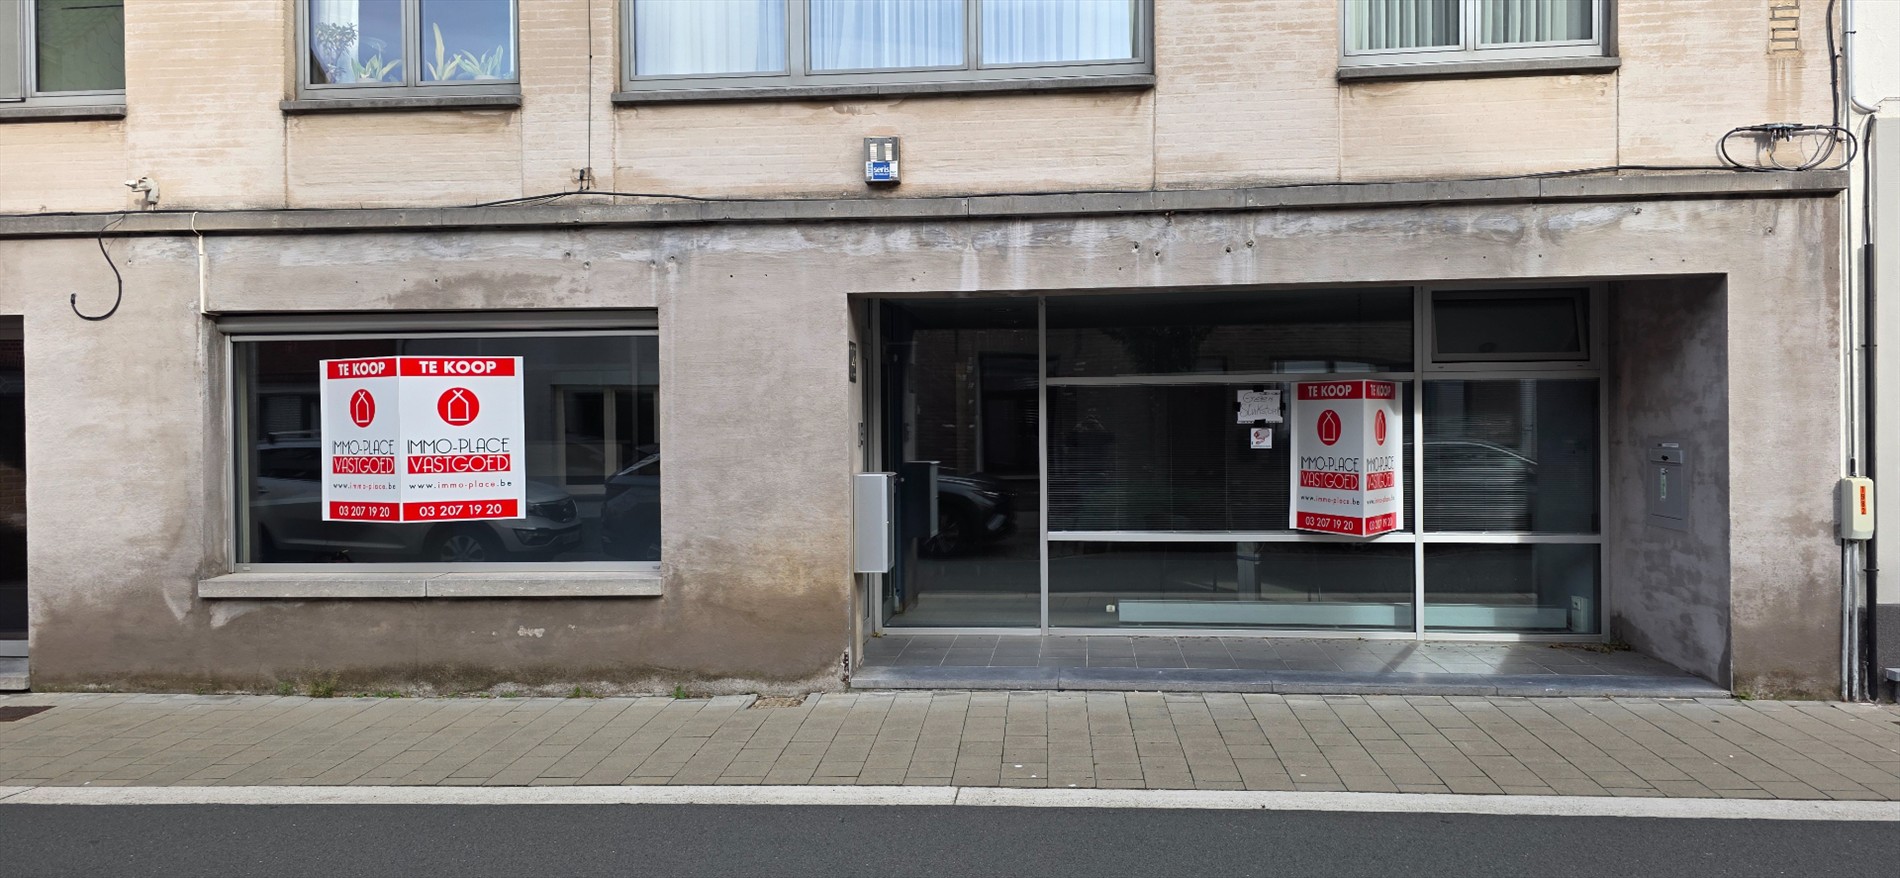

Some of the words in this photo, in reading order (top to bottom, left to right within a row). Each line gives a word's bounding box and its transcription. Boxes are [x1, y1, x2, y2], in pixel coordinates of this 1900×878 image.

[338, 363, 349, 376] TE
[352, 361, 386, 375] KOOP
[419, 360, 437, 374] TE
[444, 360, 497, 374] KOOP
[1307, 385, 1318, 397] TE
[1321, 384, 1352, 397] KOOP
[1370, 384, 1378, 396] TE
[1378, 384, 1391, 396] KOOP
[333, 439, 394, 455] IMMO-PLACE
[407, 437, 510, 454] IMMO-PLACE
[334, 456, 394, 474] VASTGOED
[409, 455, 509, 473] VASTGOED
[333, 482, 396, 490] www.immo-place.be
[409, 479, 512, 490] www.immo-place.be
[1302, 473, 1358, 490] VASTGOED
[339, 506, 348, 516] 03
[351, 506, 365, 517] 207
[369, 506, 378, 517] 19
[379, 506, 390, 517] 20
[419, 506, 435, 516] 03
[439, 505, 463, 516] 207
[468, 504, 482, 515] 19
[486, 504, 502, 514] 20
[1305, 516, 1315, 526] 03
[1316, 517, 1331, 528] 207
[1333, 519, 1341, 529] 19
[1343, 520, 1353, 530] 20
